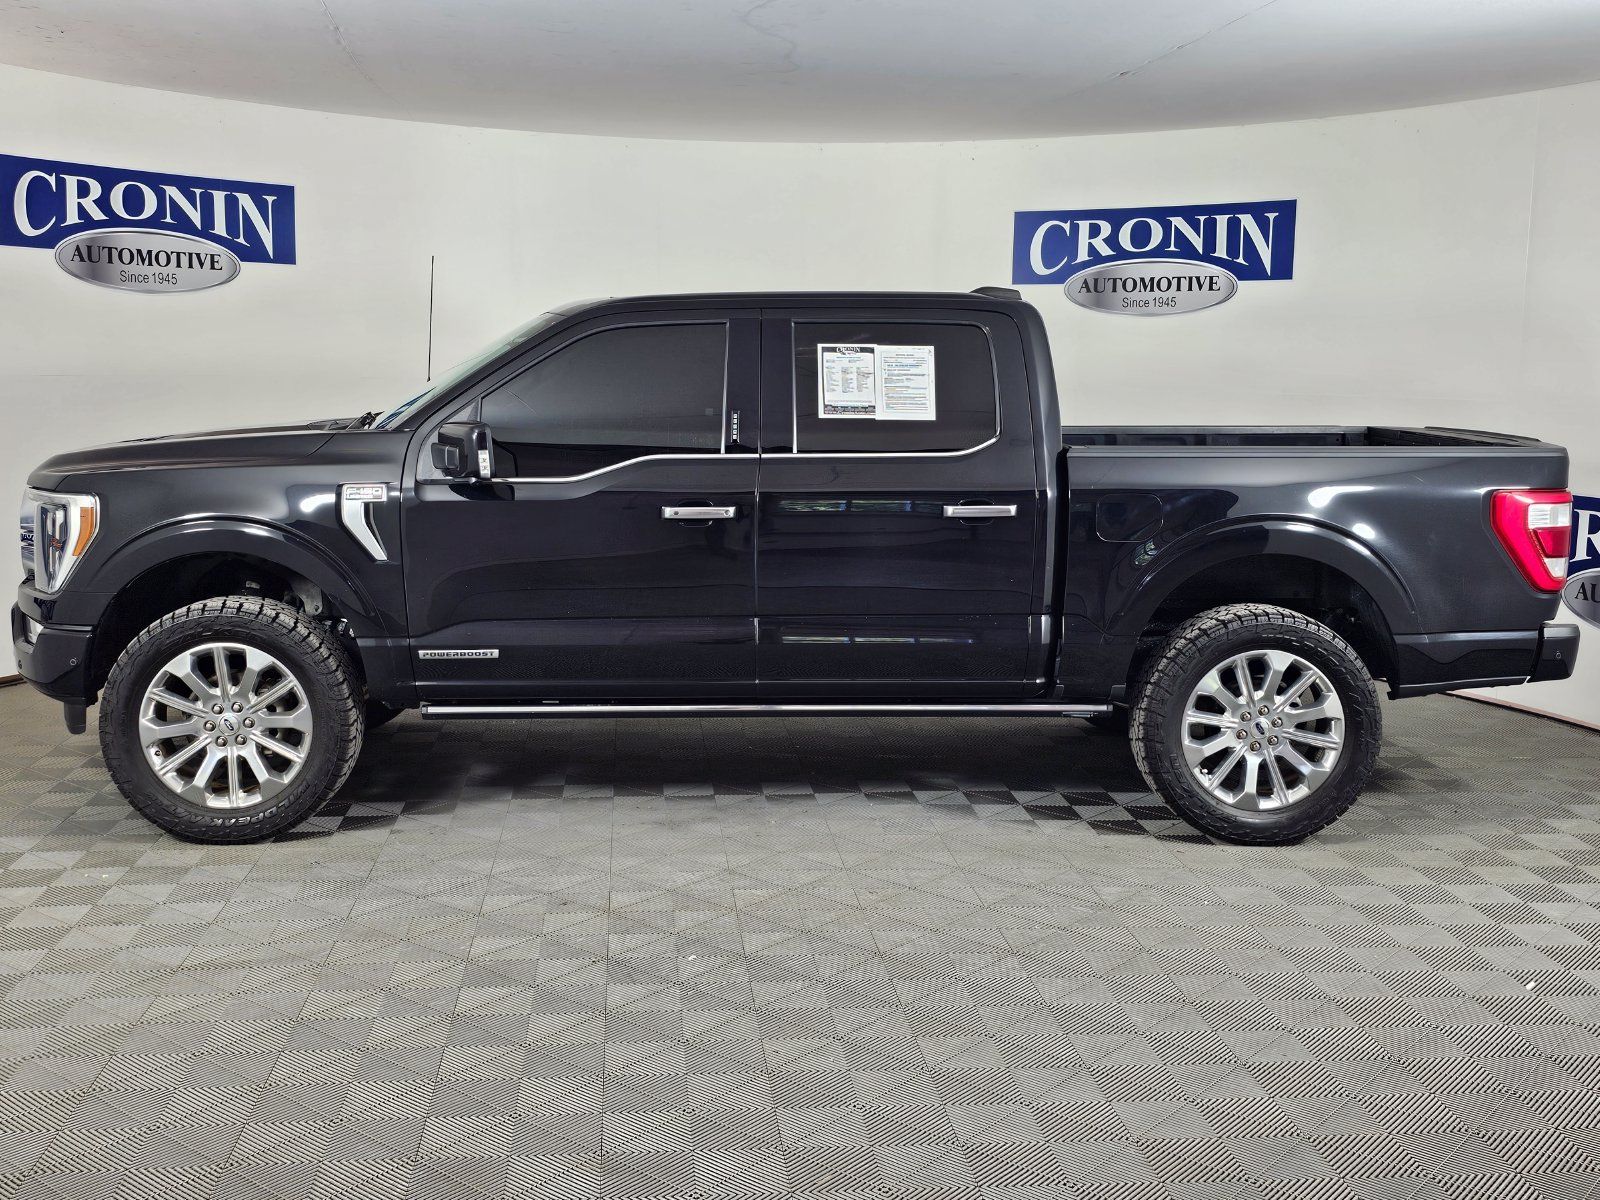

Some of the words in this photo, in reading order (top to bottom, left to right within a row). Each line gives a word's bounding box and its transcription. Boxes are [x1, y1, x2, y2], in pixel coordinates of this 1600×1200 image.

[13, 170, 278, 260] CRONIN
[1029, 212, 1279, 277] CRONIN
[70, 244, 223, 271] AUTOMOTIVE
[119, 269, 149, 284] Since
[151, 272, 178, 286] 1945
[1078, 275, 1221, 294] AUTOMOTIVE
[1121, 296, 1150, 309] Since
[1152, 296, 1177, 309] 1945
